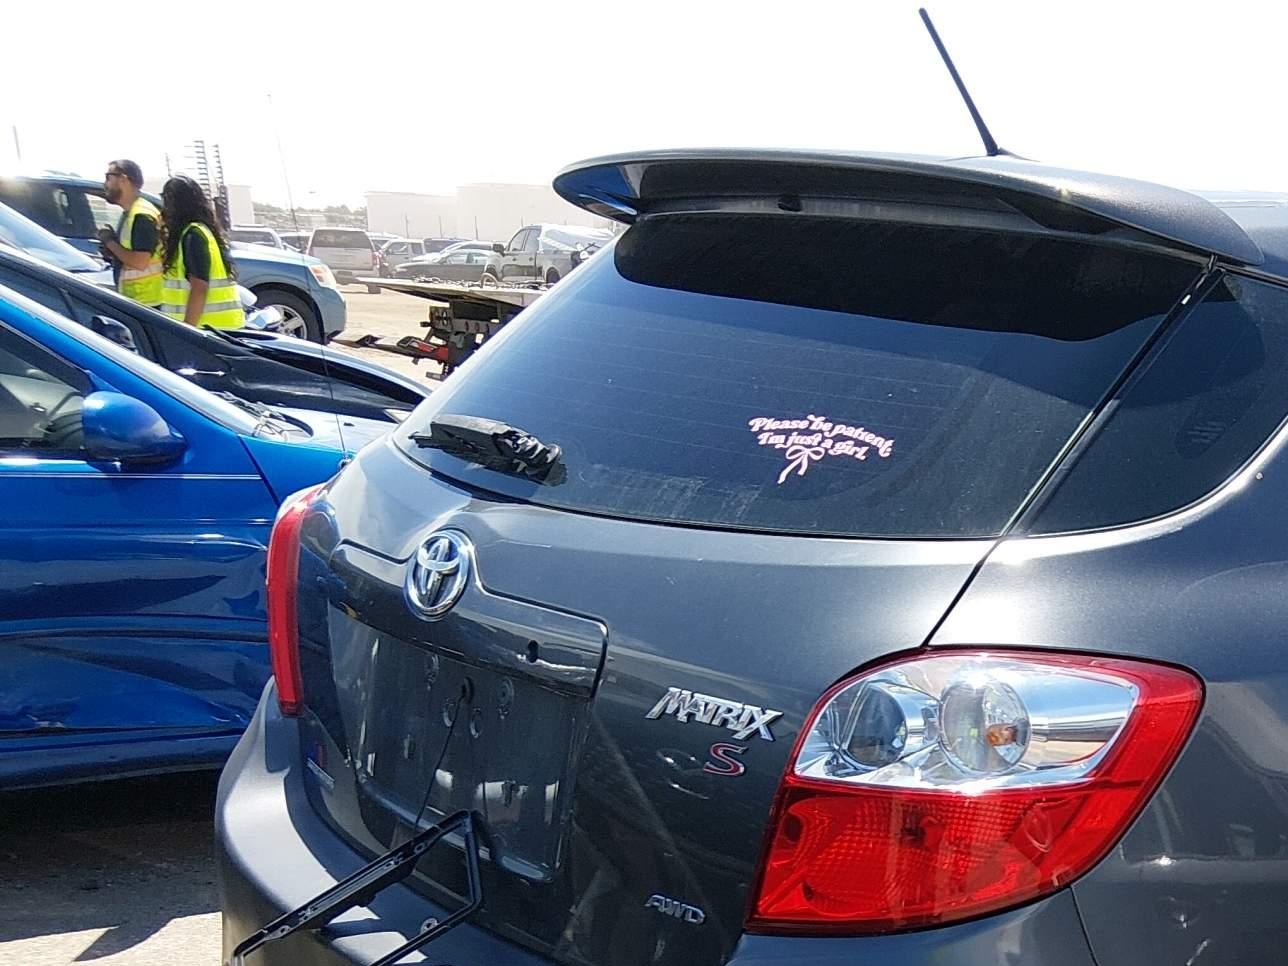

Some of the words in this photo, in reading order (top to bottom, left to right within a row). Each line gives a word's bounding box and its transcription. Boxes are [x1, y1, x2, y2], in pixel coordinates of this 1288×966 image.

[749, 417, 810, 432] Please
[806, 414, 833, 431] be
[825, 423, 895, 458] patient
[774, 431, 822, 449] just
[820, 438, 834, 449] a
[828, 440, 870, 460] girl
[645, 687, 783, 741] MATRIX
[703, 742, 748, 776] S
[644, 894, 705, 924] AWD
